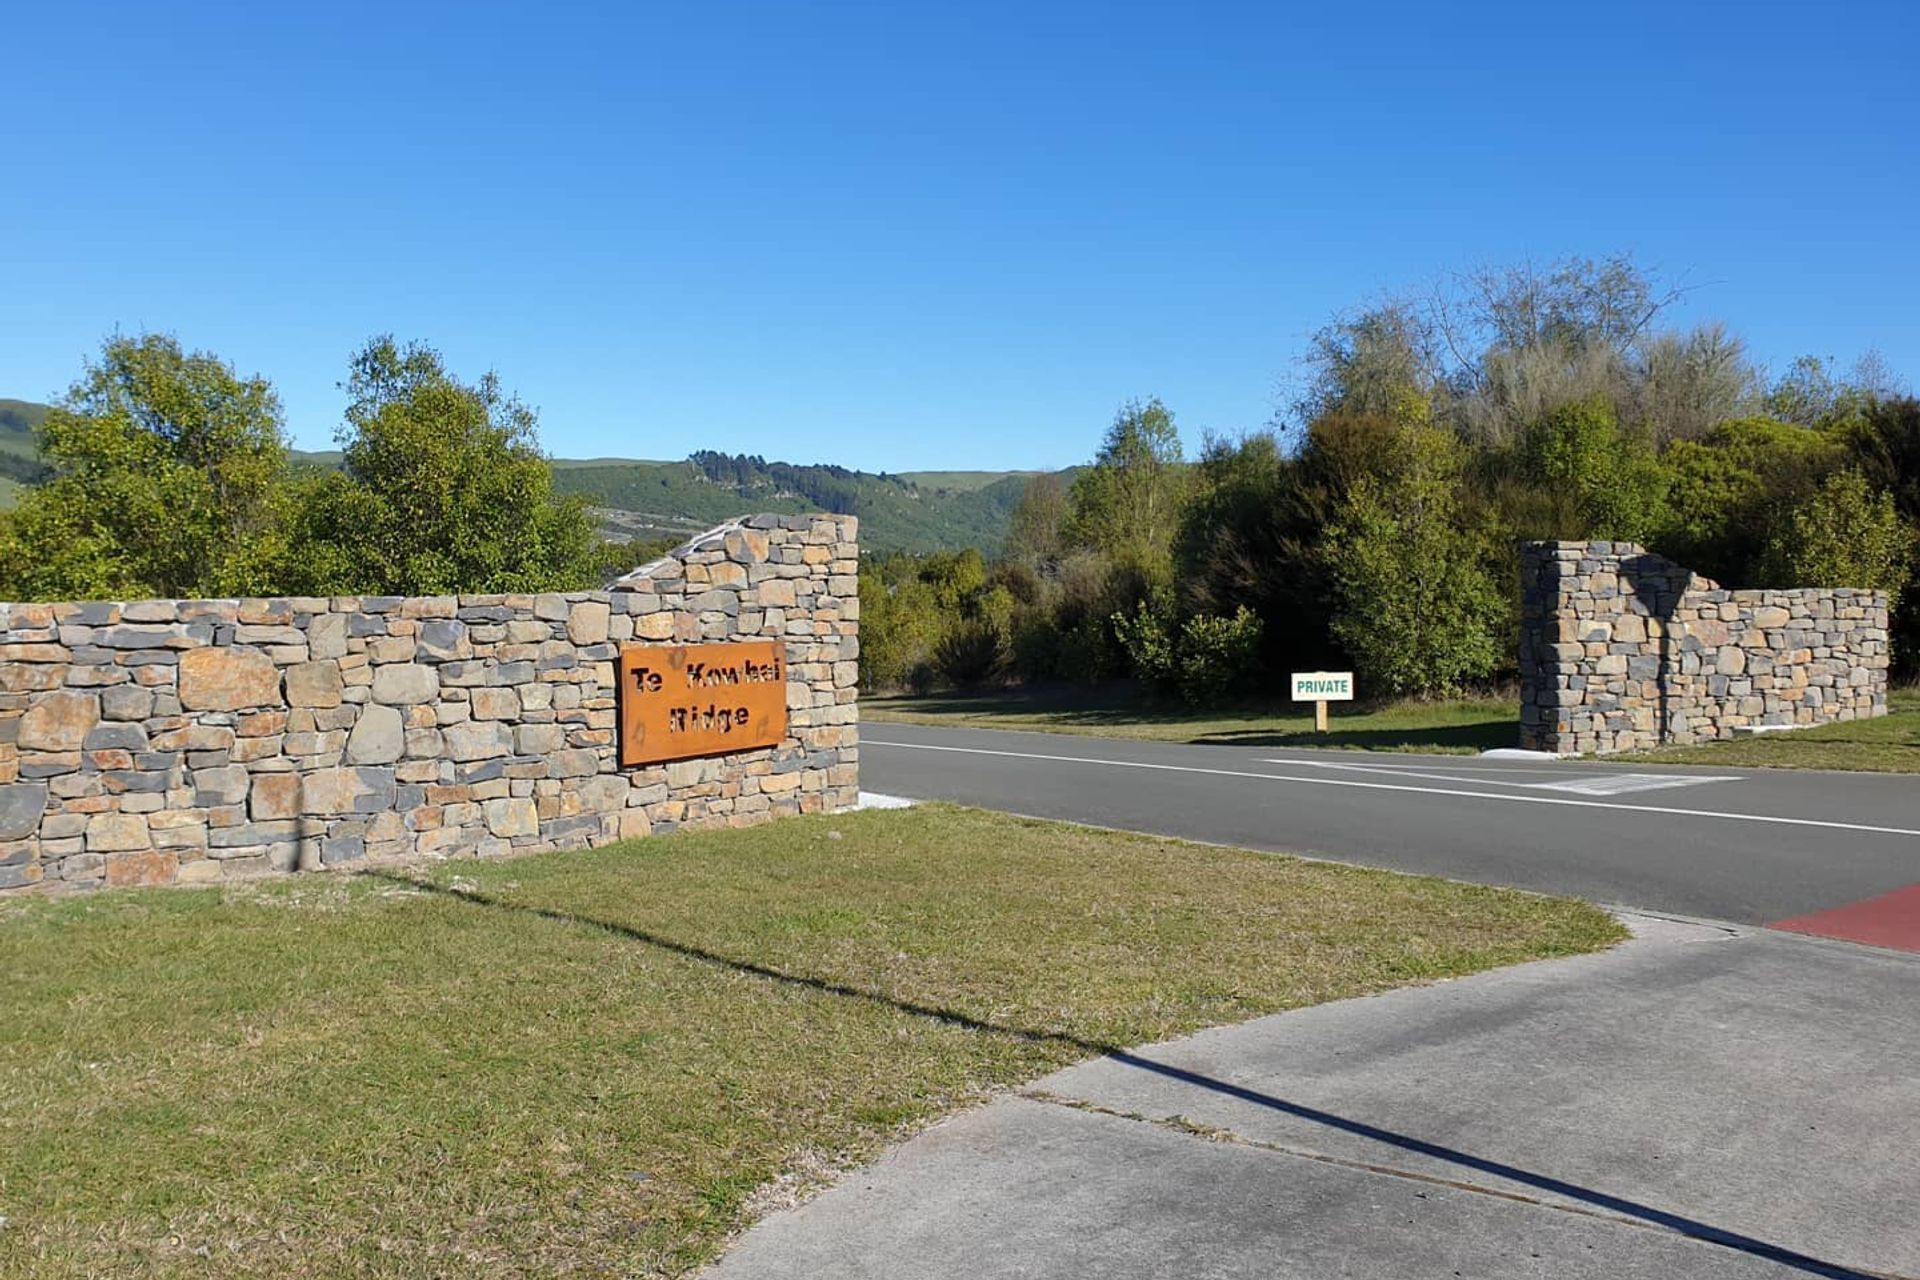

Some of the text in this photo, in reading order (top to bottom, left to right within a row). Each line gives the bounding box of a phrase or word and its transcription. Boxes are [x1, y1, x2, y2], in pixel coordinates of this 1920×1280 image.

[630, 667, 663, 693] Te
[1297, 680, 1348, 693] PRIVATE
[670, 704, 749, 733] Ridge
